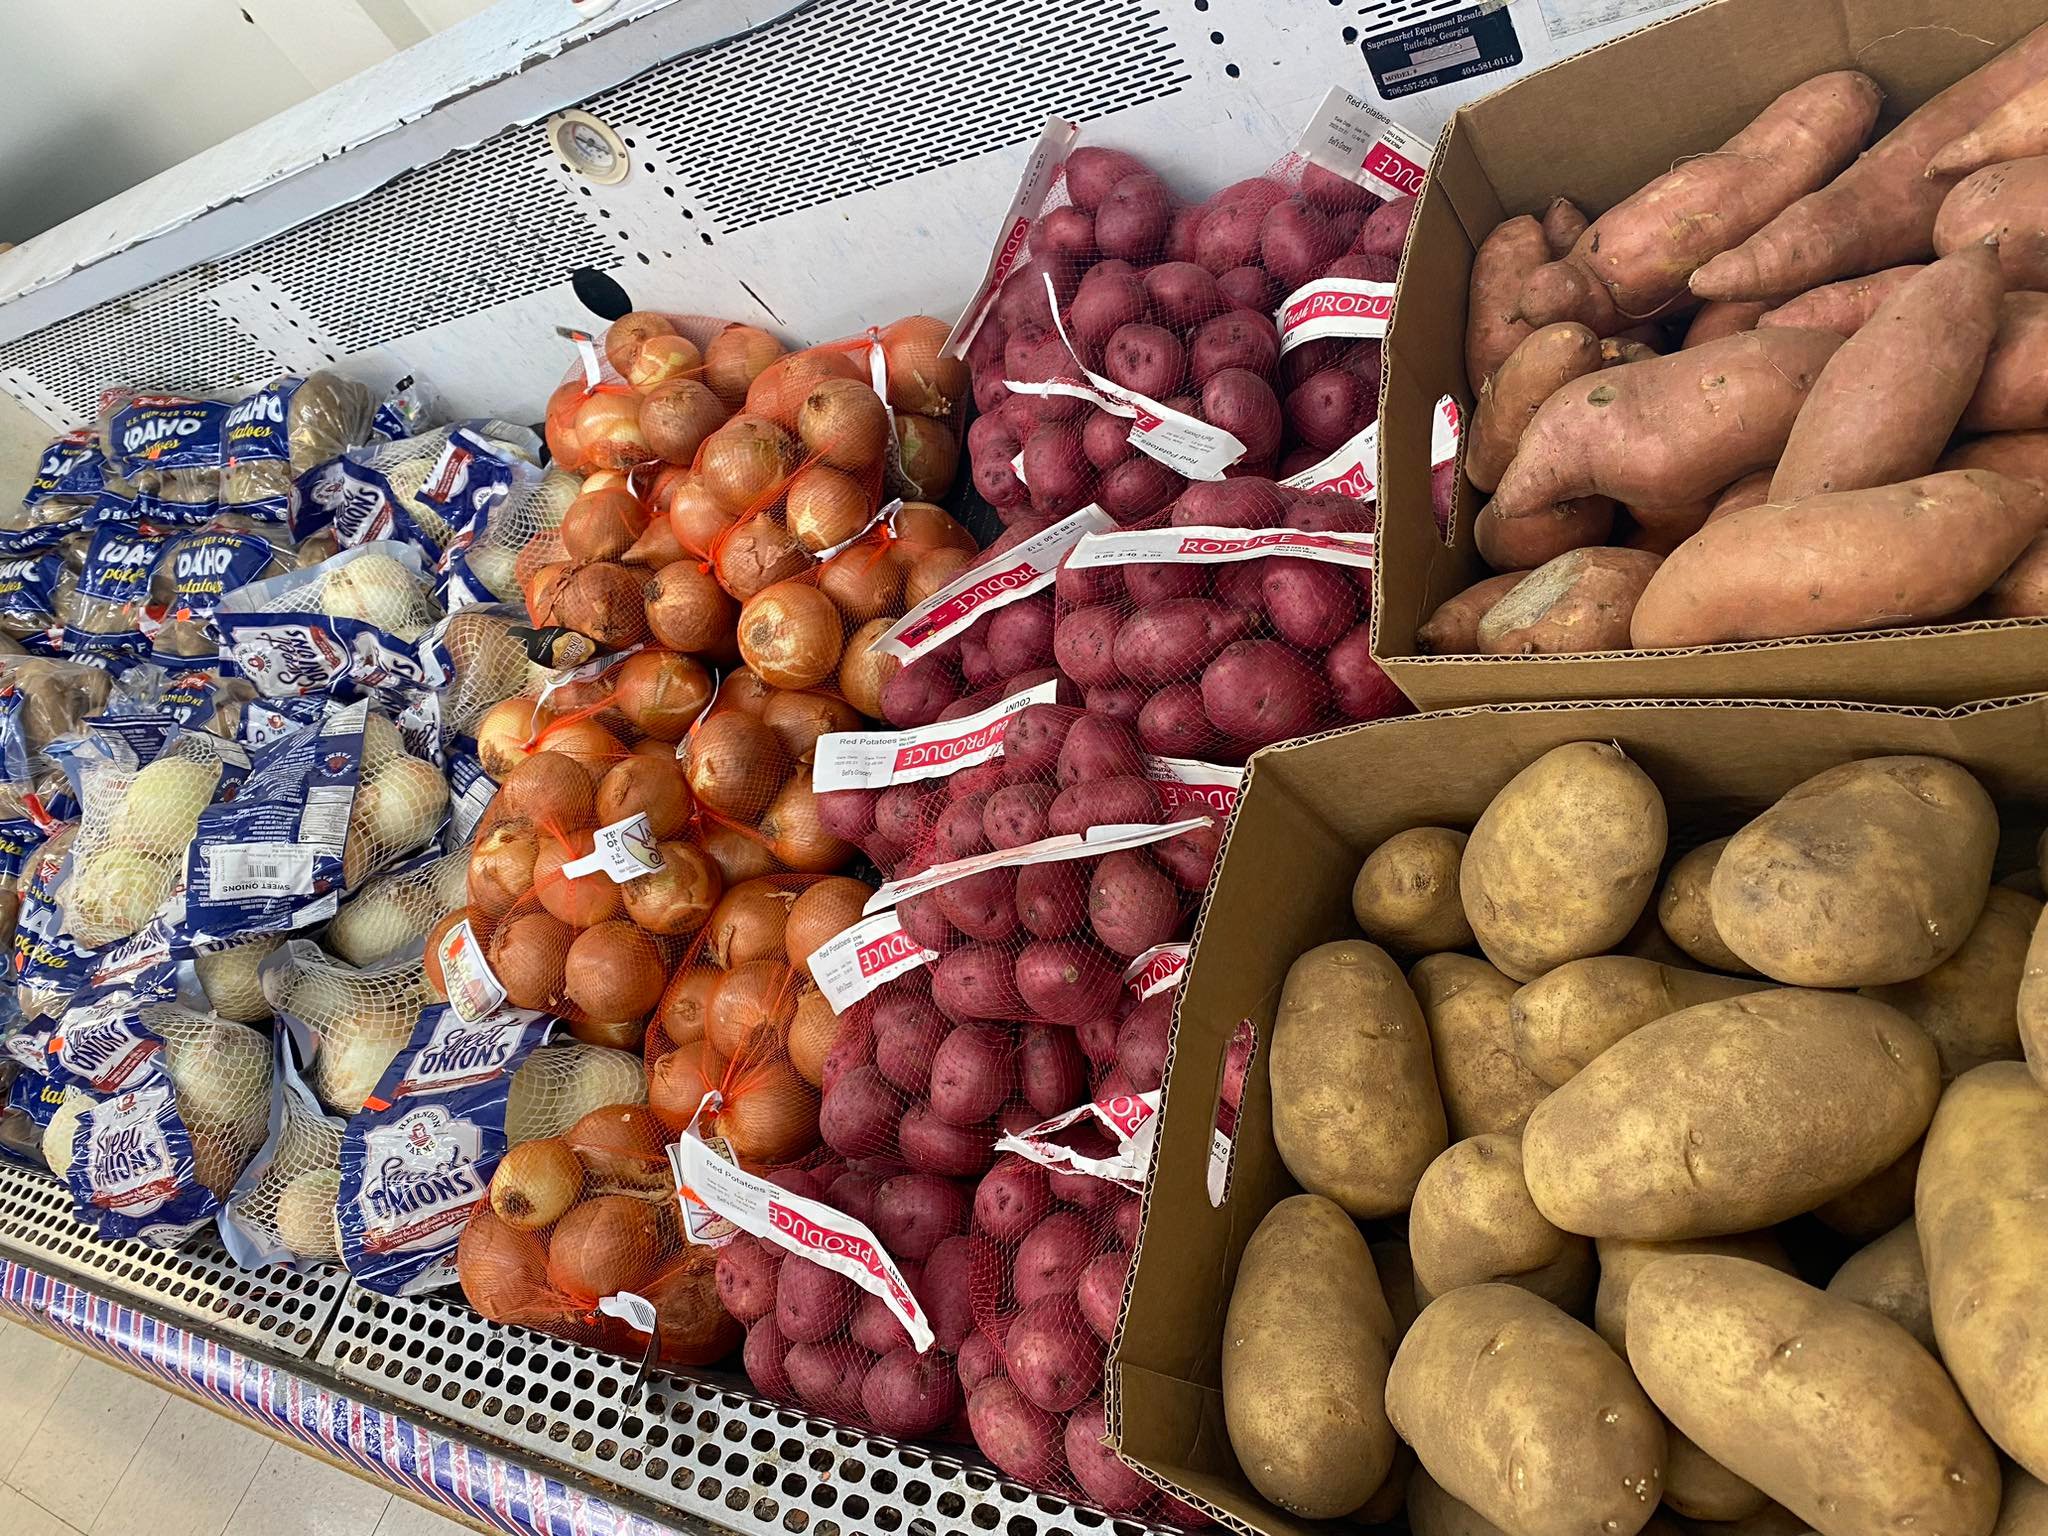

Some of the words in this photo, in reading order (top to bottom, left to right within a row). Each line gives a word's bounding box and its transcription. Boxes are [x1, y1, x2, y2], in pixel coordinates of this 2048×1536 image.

[1366, 29, 1414, 51] Supermarket
[1414, 17, 1456, 37] Equipment
[1439, 26, 1470, 42] Georgia
[1384, 70, 1411, 83] MODEL
[1461, 54, 1515, 77] 404-581-0114
[1345, 94, 1360, 108] Red
[1361, 101, 1391, 125] Potatoes
[184, 408, 208, 417] ONE
[123, 417, 202, 453] IDAHO
[1140, 439, 1179, 458] Potatoes
[1180, 453, 1199, 465] Red
[952, 566, 1039, 613] PRODUCE
[1004, 697, 1031, 714] COUNT
[859, 737, 897, 746] Potatoes
[902, 735, 987, 767] PRODUCE
[222, 882, 258, 893] ONIONS
[261, 883, 291, 892] SWEET
[442, 1017, 521, 1050] Sweet
[72, 1024, 130, 1071] ONIONS
[421, 1042, 509, 1075] ONIONS
[398, 1112, 441, 1132] HERNDON
[404, 1141, 437, 1155] FARMS
[706, 1159, 723, 1174] Red
[725, 1170, 766, 1194] Potatoes
[367, 1171, 475, 1220] ONIONS
[768, 1206, 874, 1264] PRODUCE
